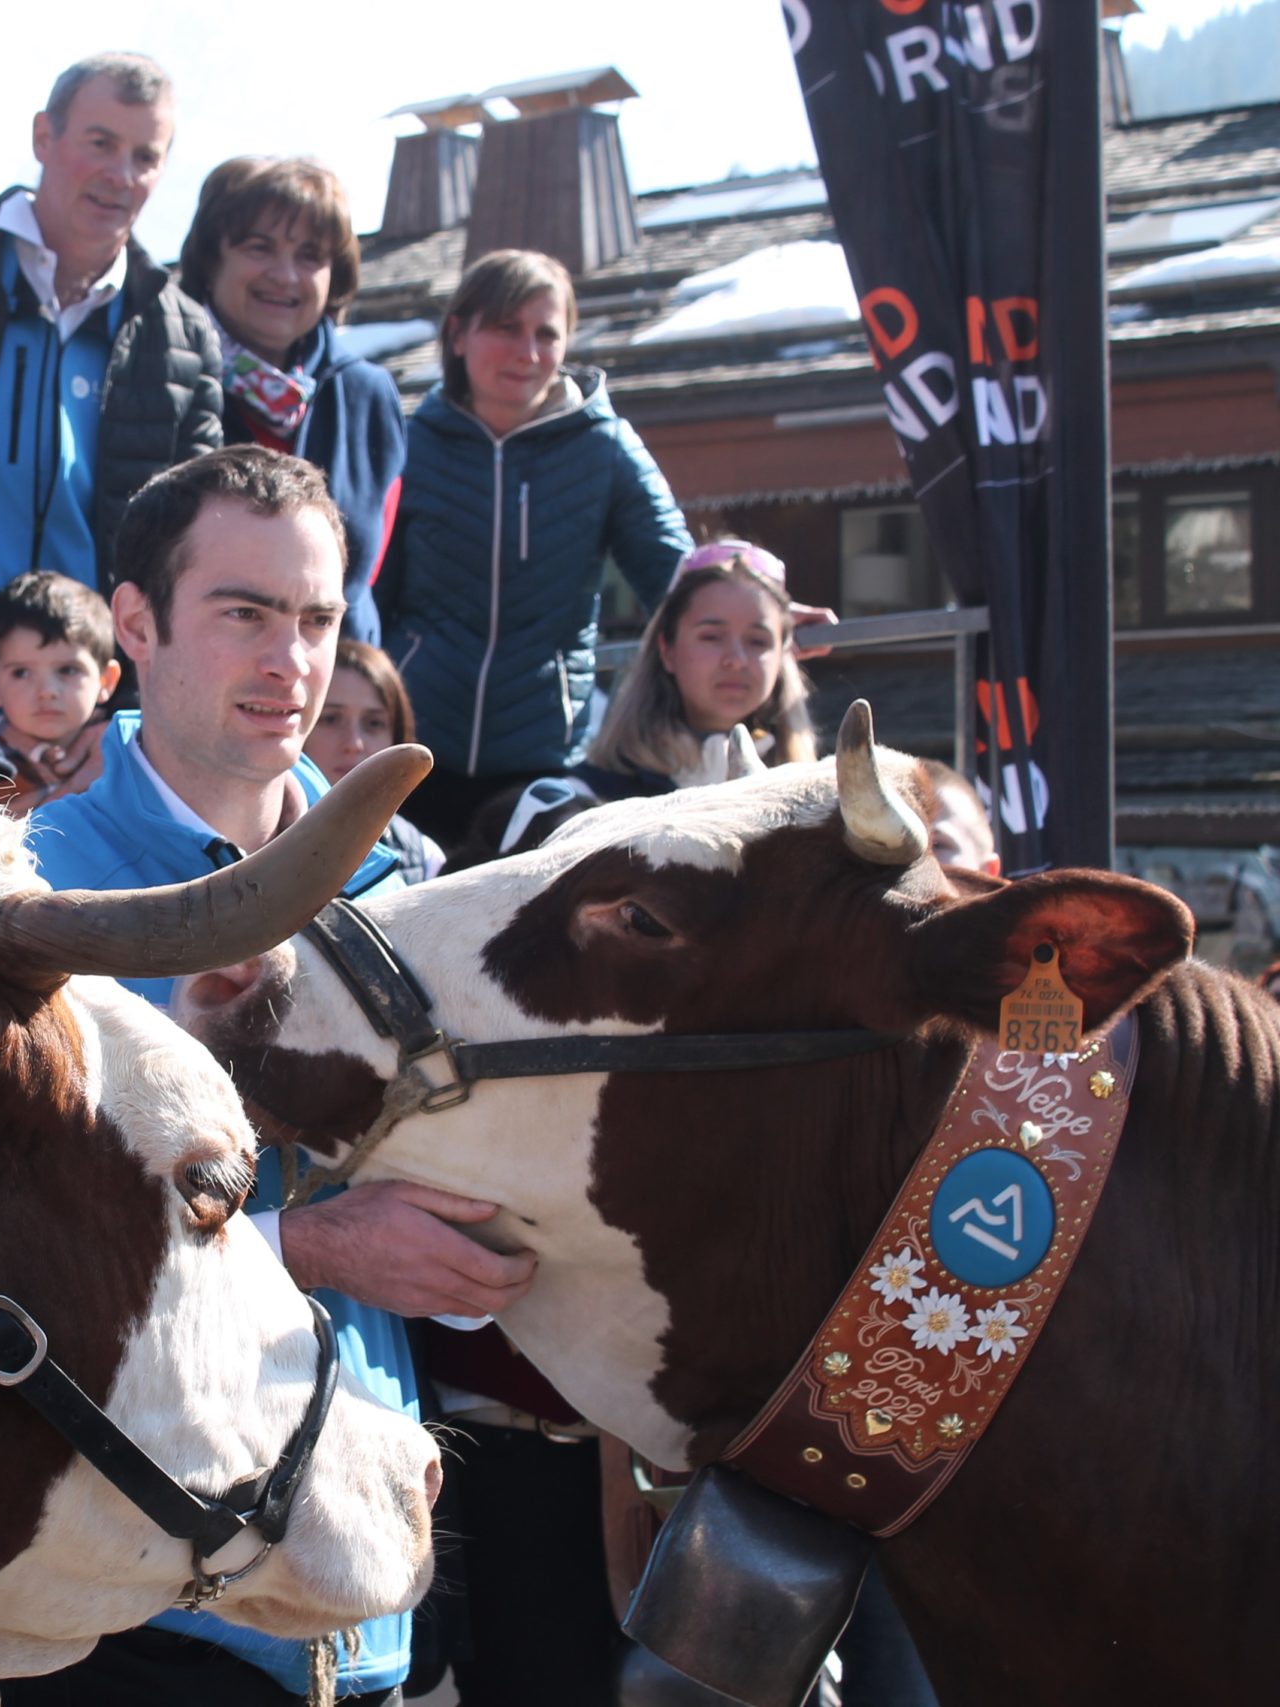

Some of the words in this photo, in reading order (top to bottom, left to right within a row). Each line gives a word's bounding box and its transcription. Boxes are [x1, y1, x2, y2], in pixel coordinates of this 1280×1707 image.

[1005, 1019, 1079, 1052] 8363
[984, 1051, 1093, 1140] Neige
[851, 1379, 927, 1426] 2022
[865, 1347, 944, 1406] Paris
